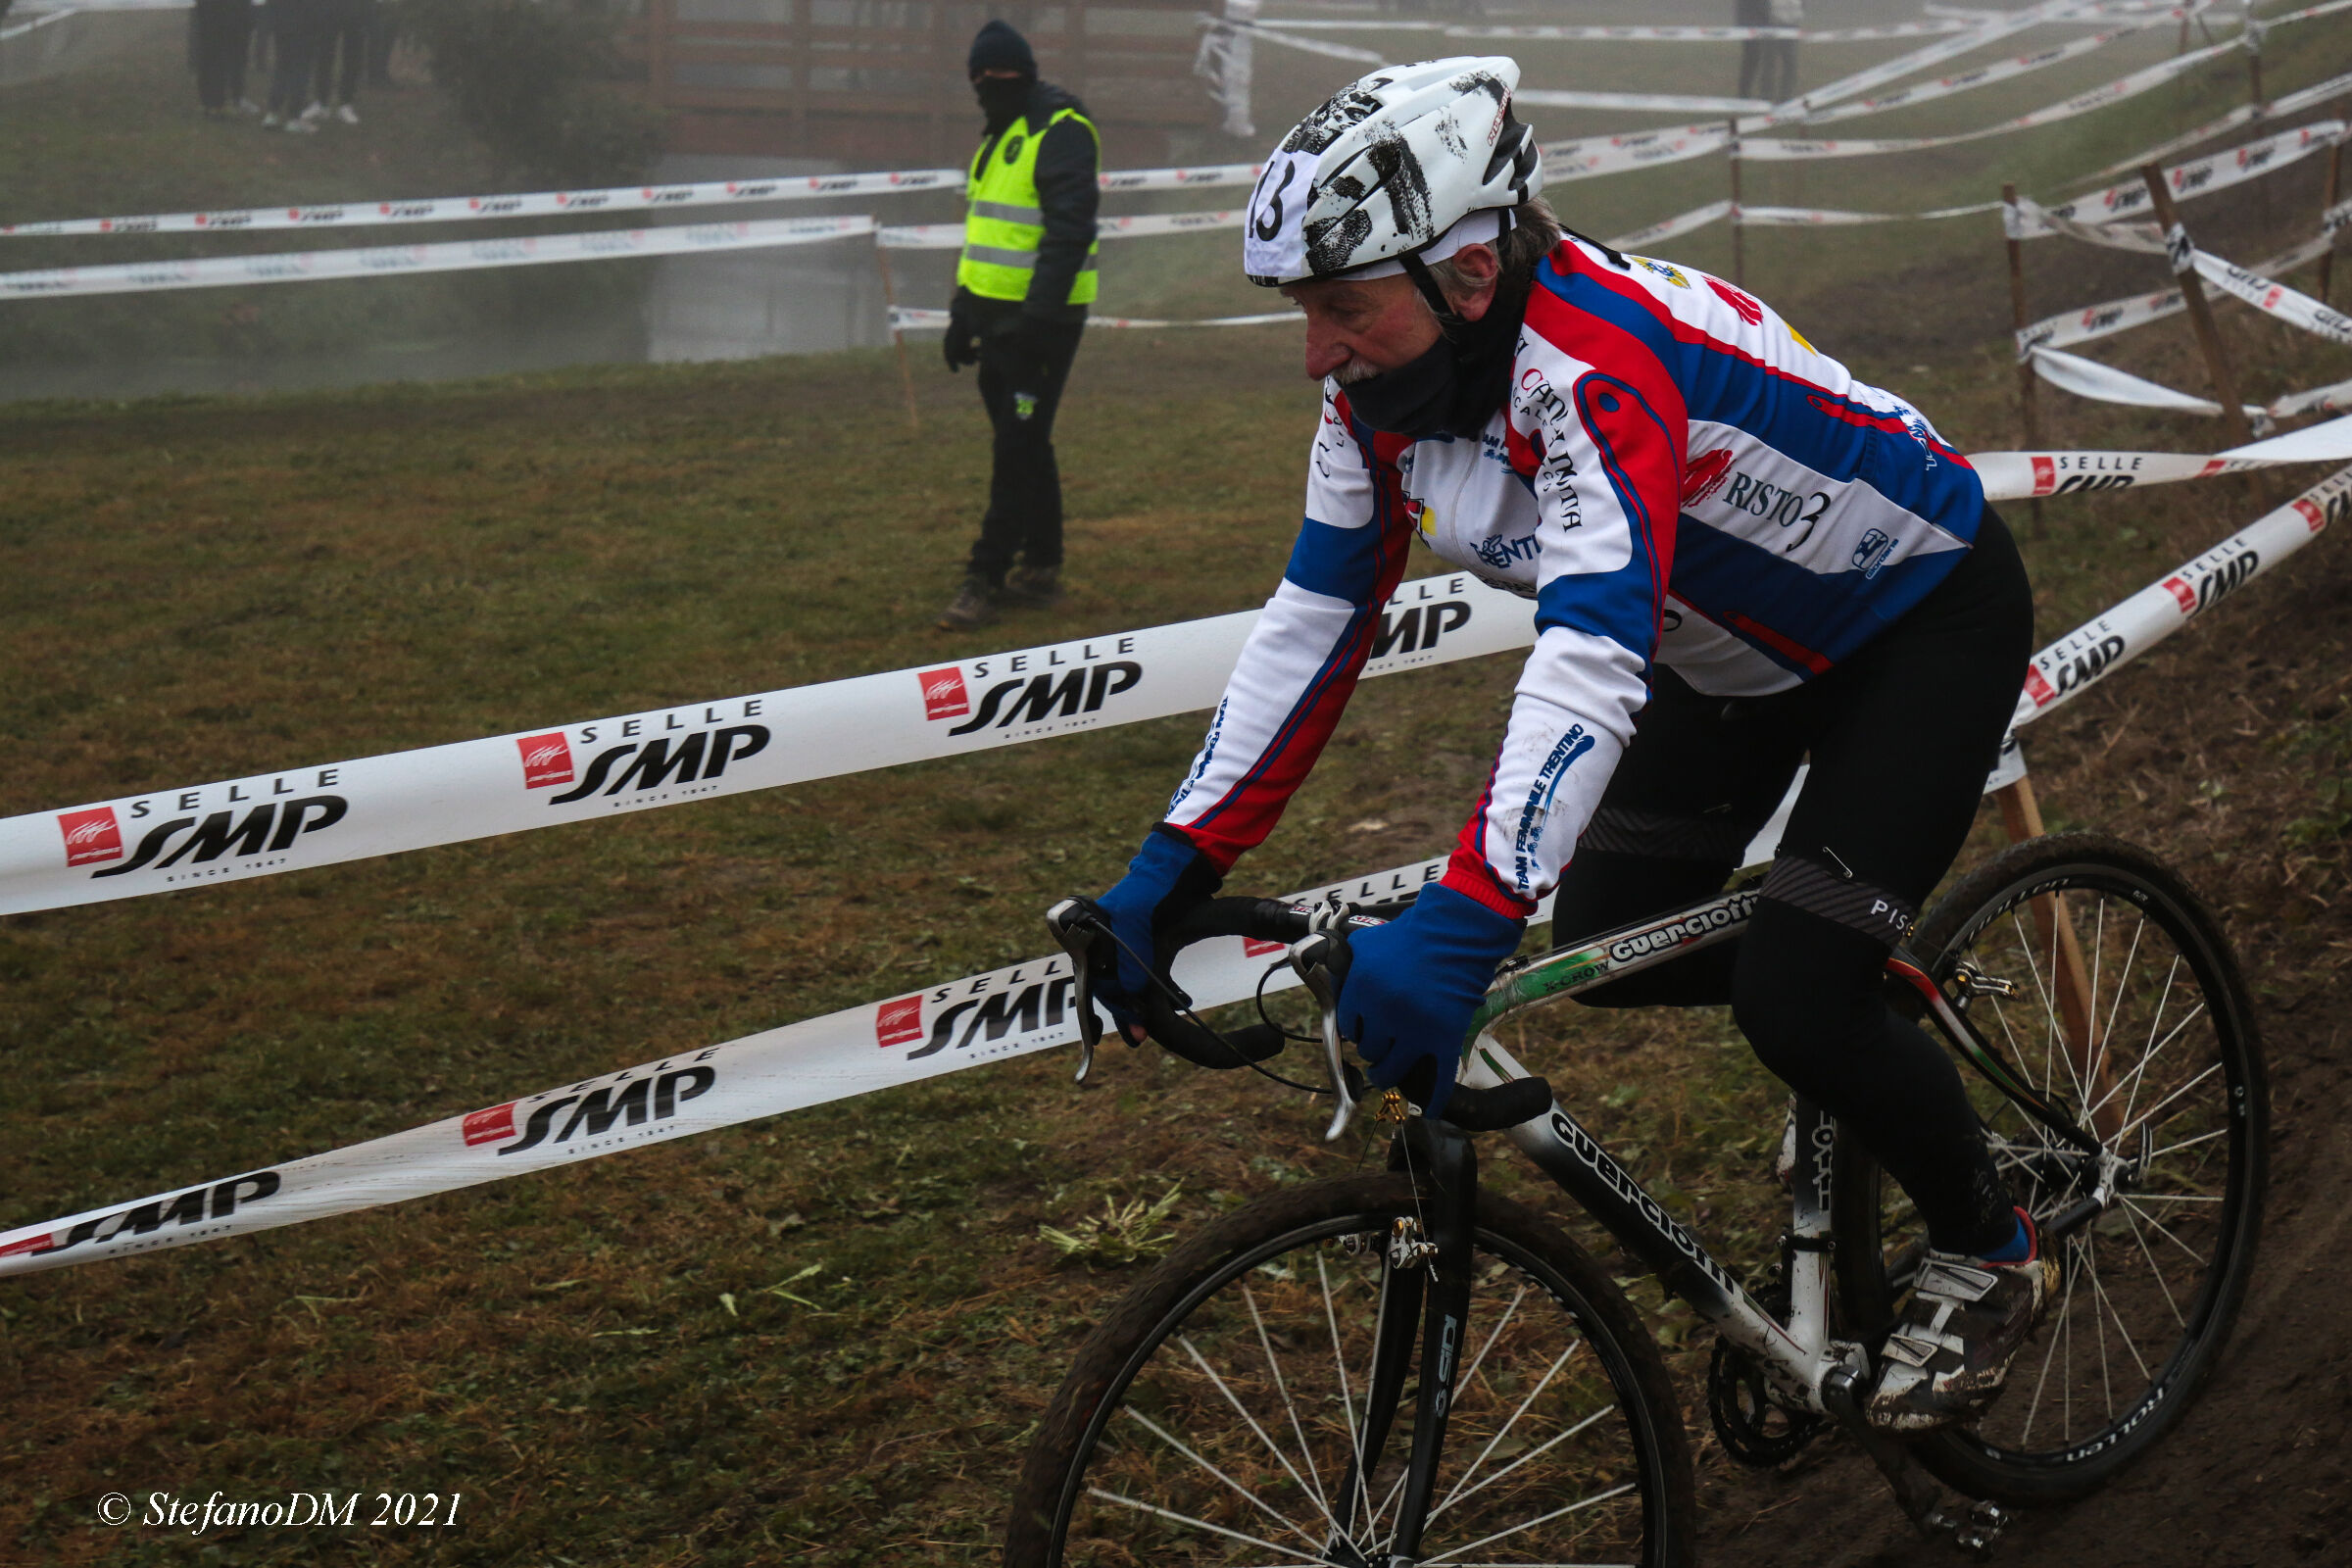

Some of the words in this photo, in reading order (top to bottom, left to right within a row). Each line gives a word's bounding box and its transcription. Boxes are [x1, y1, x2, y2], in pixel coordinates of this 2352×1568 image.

[1249, 160, 1296, 242] 13
[2059, 457, 2143, 470] SELLE
[2181, 537, 2248, 580] SELLE
[1389, 576, 1465, 606] LLE
[973, 637, 1136, 679] SELLE
[1369, 600, 1472, 661] MP
[2039, 619, 2111, 670] SELLE
[579, 699, 763, 744] SELLE
[948, 660, 1144, 737] SMP
[130, 767, 340, 819] SELLE
[548, 724, 771, 807] SMP
[1515, 856, 1530, 890] TEAM
[1539, 723, 1585, 780] TRENTINO
[90, 794, 349, 879] SMP
[931, 960, 1062, 1004] SELL
[526, 1047, 720, 1103] SELLE
[498, 1065, 716, 1156] SMP
[30, 1171, 281, 1257] SMP
